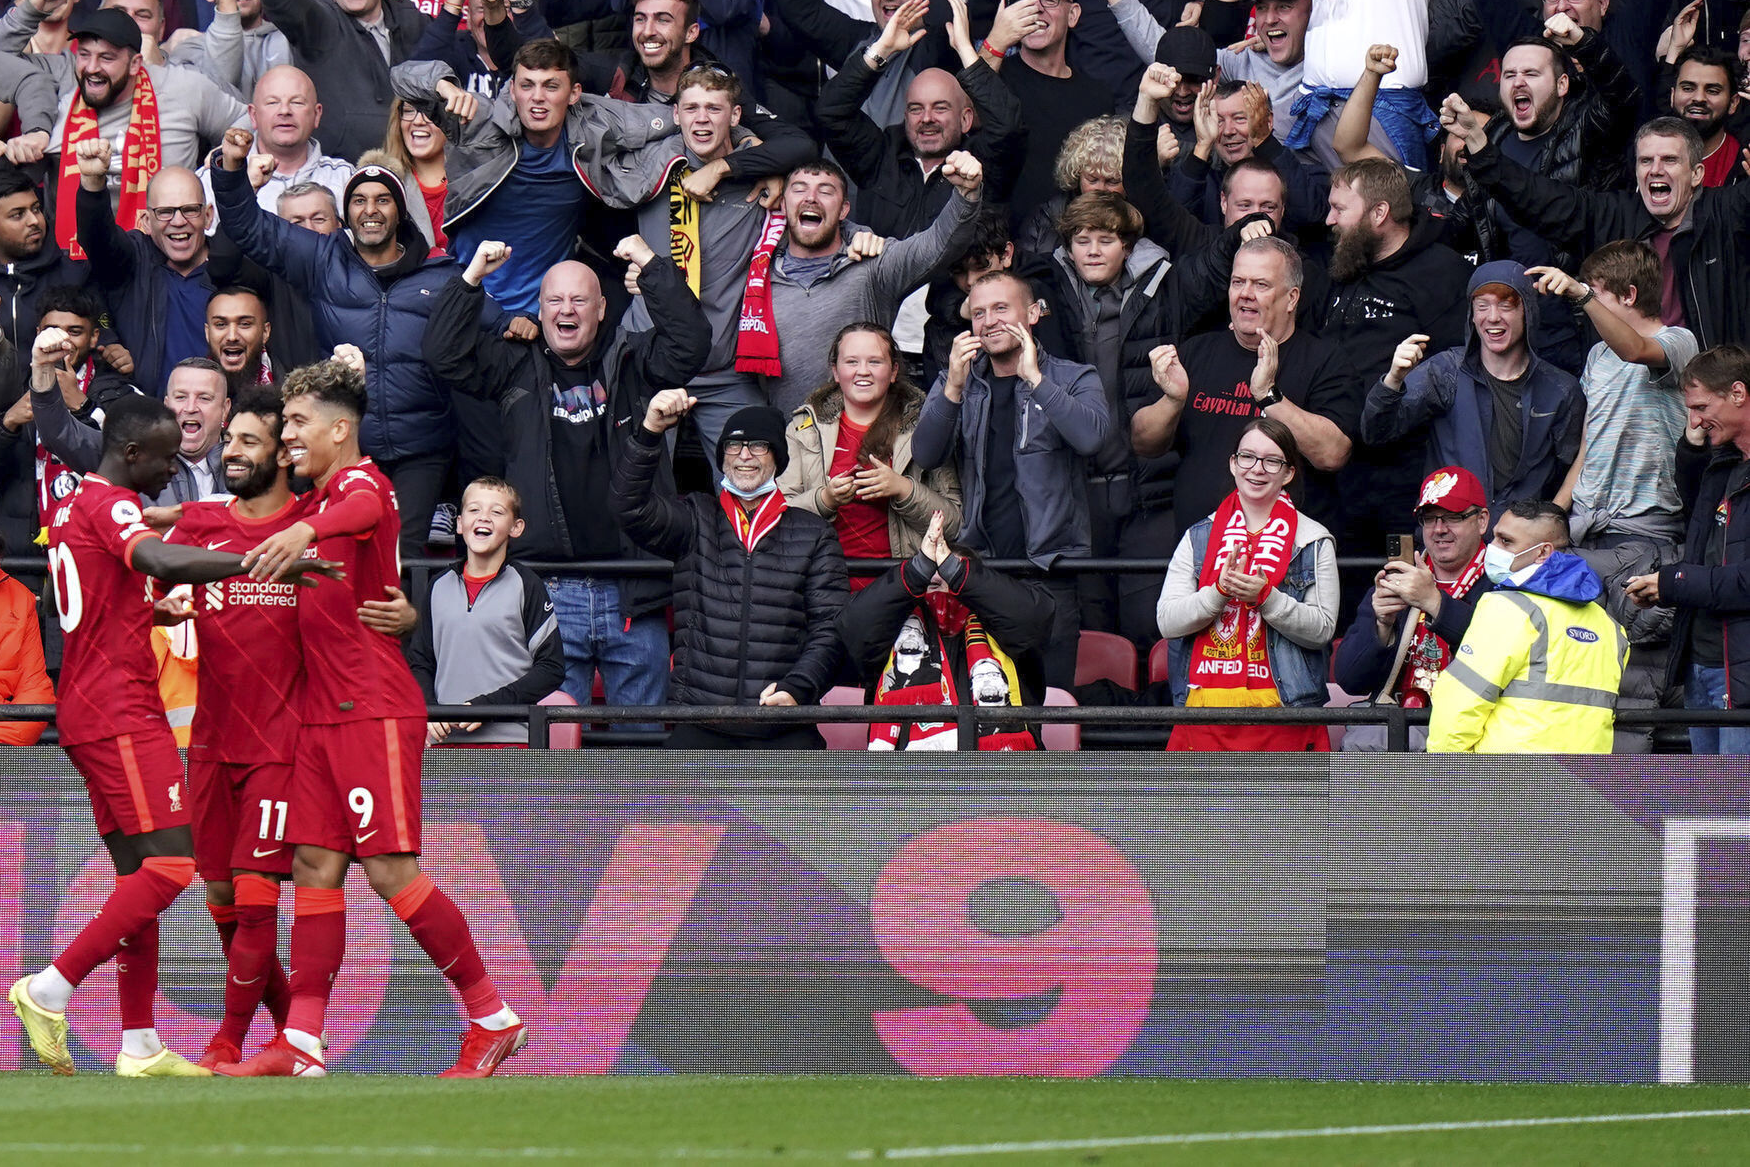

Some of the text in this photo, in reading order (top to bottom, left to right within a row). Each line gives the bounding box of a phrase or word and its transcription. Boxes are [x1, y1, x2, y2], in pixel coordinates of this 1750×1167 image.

[1192, 391, 1250, 417] Egyptian
[228, 580, 295, 594] standard
[228, 593, 297, 608] chartered
[258, 799, 288, 841] 11
[347, 787, 374, 829] 9
[870, 815, 1156, 1077] 9
